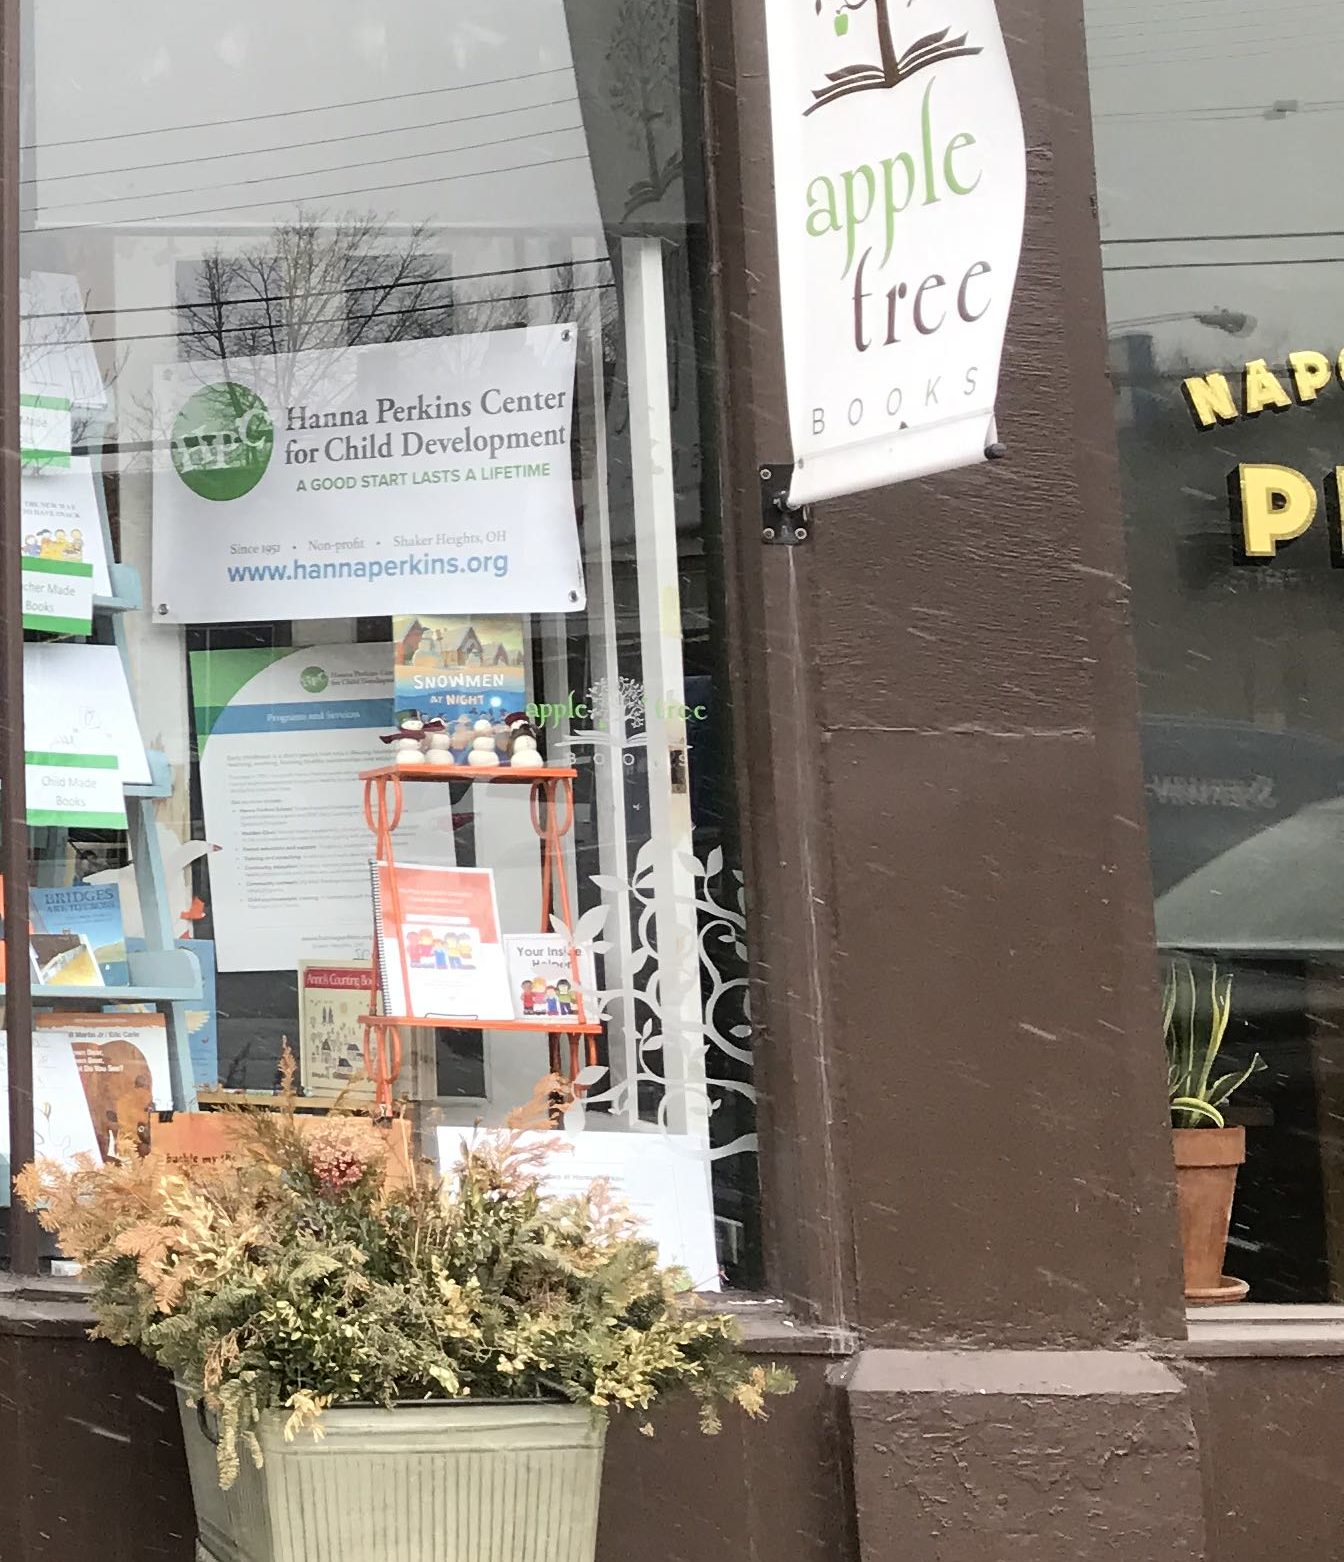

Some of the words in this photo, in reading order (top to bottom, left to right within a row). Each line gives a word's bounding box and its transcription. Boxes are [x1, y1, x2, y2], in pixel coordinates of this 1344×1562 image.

[805, 76, 984, 280] apple
[852, 247, 993, 353] tree
[285, 405, 368, 431] Hanna
[375, 394, 472, 424] Perkins
[480, 388, 566, 415] Center
[812, 367, 979, 436] BOOKS
[284, 439, 320, 465] for
[324, 432, 393, 462] Child
[401, 425, 566, 460] Development
[296, 479, 307, 492] A
[310, 476, 357, 491] GOOD
[361, 473, 408, 489] START
[412, 469, 461, 485] LASTS
[464, 468, 477, 481] A
[481, 462, 551, 481] LIFETIME
[230, 544, 260, 555] Since
[308, 538, 364, 553] Non-profit
[393, 534, 433, 547] Shaker
[436, 532, 484, 548] Heights,
[486, 530, 507, 544] OH
[227, 553, 508, 583] www.hannaperkins.org
[25, 600, 55, 613] Books
[413, 674, 505, 690] SNOWMEN
[446, 695, 485, 706] NIGHT
[525, 690, 588, 729] apple
[41, 775, 65, 789] Child
[68, 777, 97, 790] Made
[56, 795, 87, 809] Books
[45, 887, 115, 905] BRIDGES
[517, 946, 543, 957] Your
